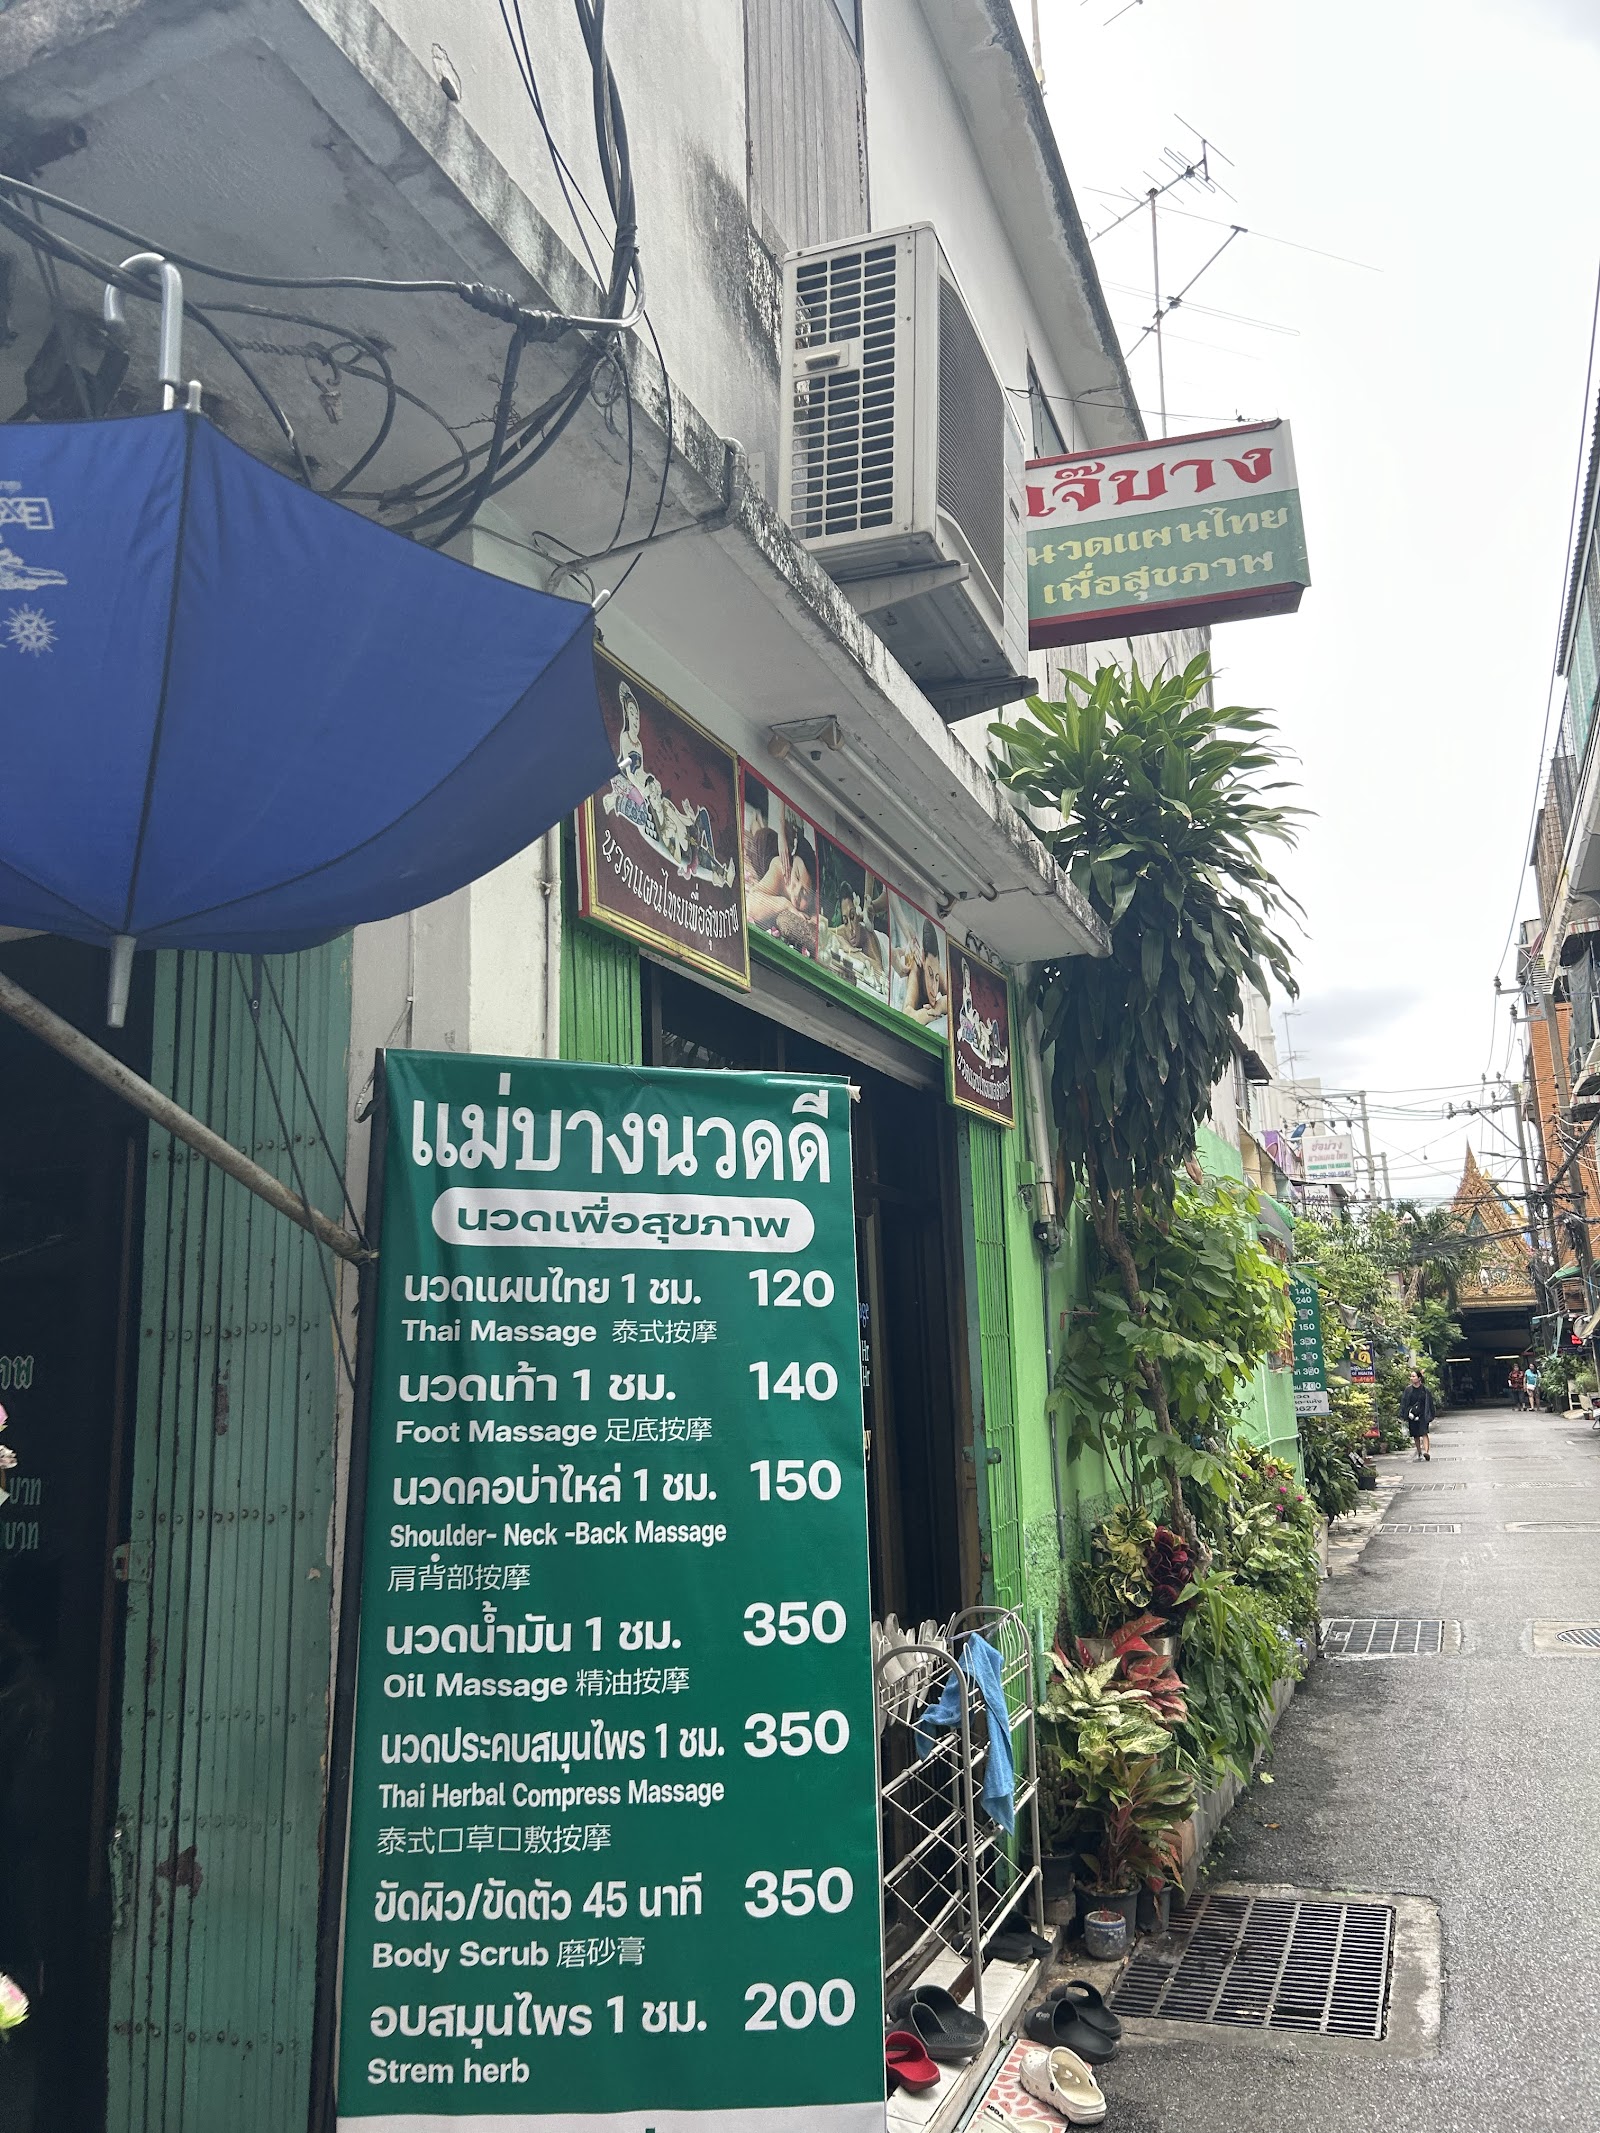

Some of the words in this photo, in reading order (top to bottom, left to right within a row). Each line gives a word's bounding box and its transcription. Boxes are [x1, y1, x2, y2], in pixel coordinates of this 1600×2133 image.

[1026, 447, 1274, 517] เจ๊บาง
[1028, 507, 1289, 566] นวดแผนไทย
[1043, 551, 1274, 604] เพื่อสุขภาพ
[411, 1073, 831, 1184] แม่บางนวดดี
[457, 1195, 791, 1245] นวดเพื่อสุขภาพ
[404, 1266, 610, 1304] นวดแผนไทย
[621, 1273, 636, 1304] 1
[649, 1278, 702, 1305] ชม.
[748, 1268, 835, 1308] 120
[401, 1318, 461, 1342] Thai
[470, 1319, 597, 1347] Massage
[611, 1318, 718, 1344] 泰式按摩
[399, 1360, 558, 1403] นวดเท้า
[572, 1368, 591, 1401] 1
[608, 1373, 676, 1401] ชม.
[749, 1361, 839, 1401] 140
[395, 1420, 460, 1444] Foot
[469, 1419, 598, 1447] Massage
[604, 1416, 713, 1443] 足底按摩
[393, 1463, 622, 1506] นวดคอบ่าไหล่
[633, 1468, 648, 1502] 1
[662, 1473, 717, 1502] ชม.
[750, 1459, 842, 1501] 150
[390, 1523, 497, 1548] Shoulder-
[503, 1522, 558, 1547] Neck
[564, 1520, 628, 1545] -Back
[635, 1520, 727, 1548] Massage
[387, 1564, 531, 1592] 肩背部按摩
[386, 1600, 572, 1655] นวดน้ำมัน
[585, 1616, 602, 1652] 1
[618, 1620, 682, 1651] ชม.
[743, 1600, 847, 1647] 350
[383, 1672, 426, 1698] Oil
[435, 1672, 568, 1703] Massage
[575, 1666, 690, 1697] 精油按摩
[381, 1718, 646, 1774] นวดประคบสมุนไพร
[655, 1722, 668, 1759] 1
[679, 1727, 725, 1758] ชม.
[743, 1709, 850, 1758] 350
[378, 1782, 426, 1809] Thai
[432, 1781, 506, 1808] Herbal
[512, 1782, 622, 1812] Compress
[628, 1779, 725, 1808] Massage
[374, 1877, 572, 1923] ขัดผิว/ขัดตัว
[582, 1880, 628, 1919] 45
[639, 1872, 702, 1918] นาที
[744, 1866, 854, 1919] 350
[372, 1942, 451, 1974] Body
[459, 1940, 549, 1967] Scrub
[556, 1936, 646, 1969] 磨砂膏
[370, 1991, 593, 2050] อบสมุนไพร
[606, 1995, 624, 2034] 1
[641, 2000, 707, 2033] ชม.
[744, 1978, 856, 2031] 200
[367, 2057, 454, 2085] Strem
[463, 2057, 530, 2084] herb
